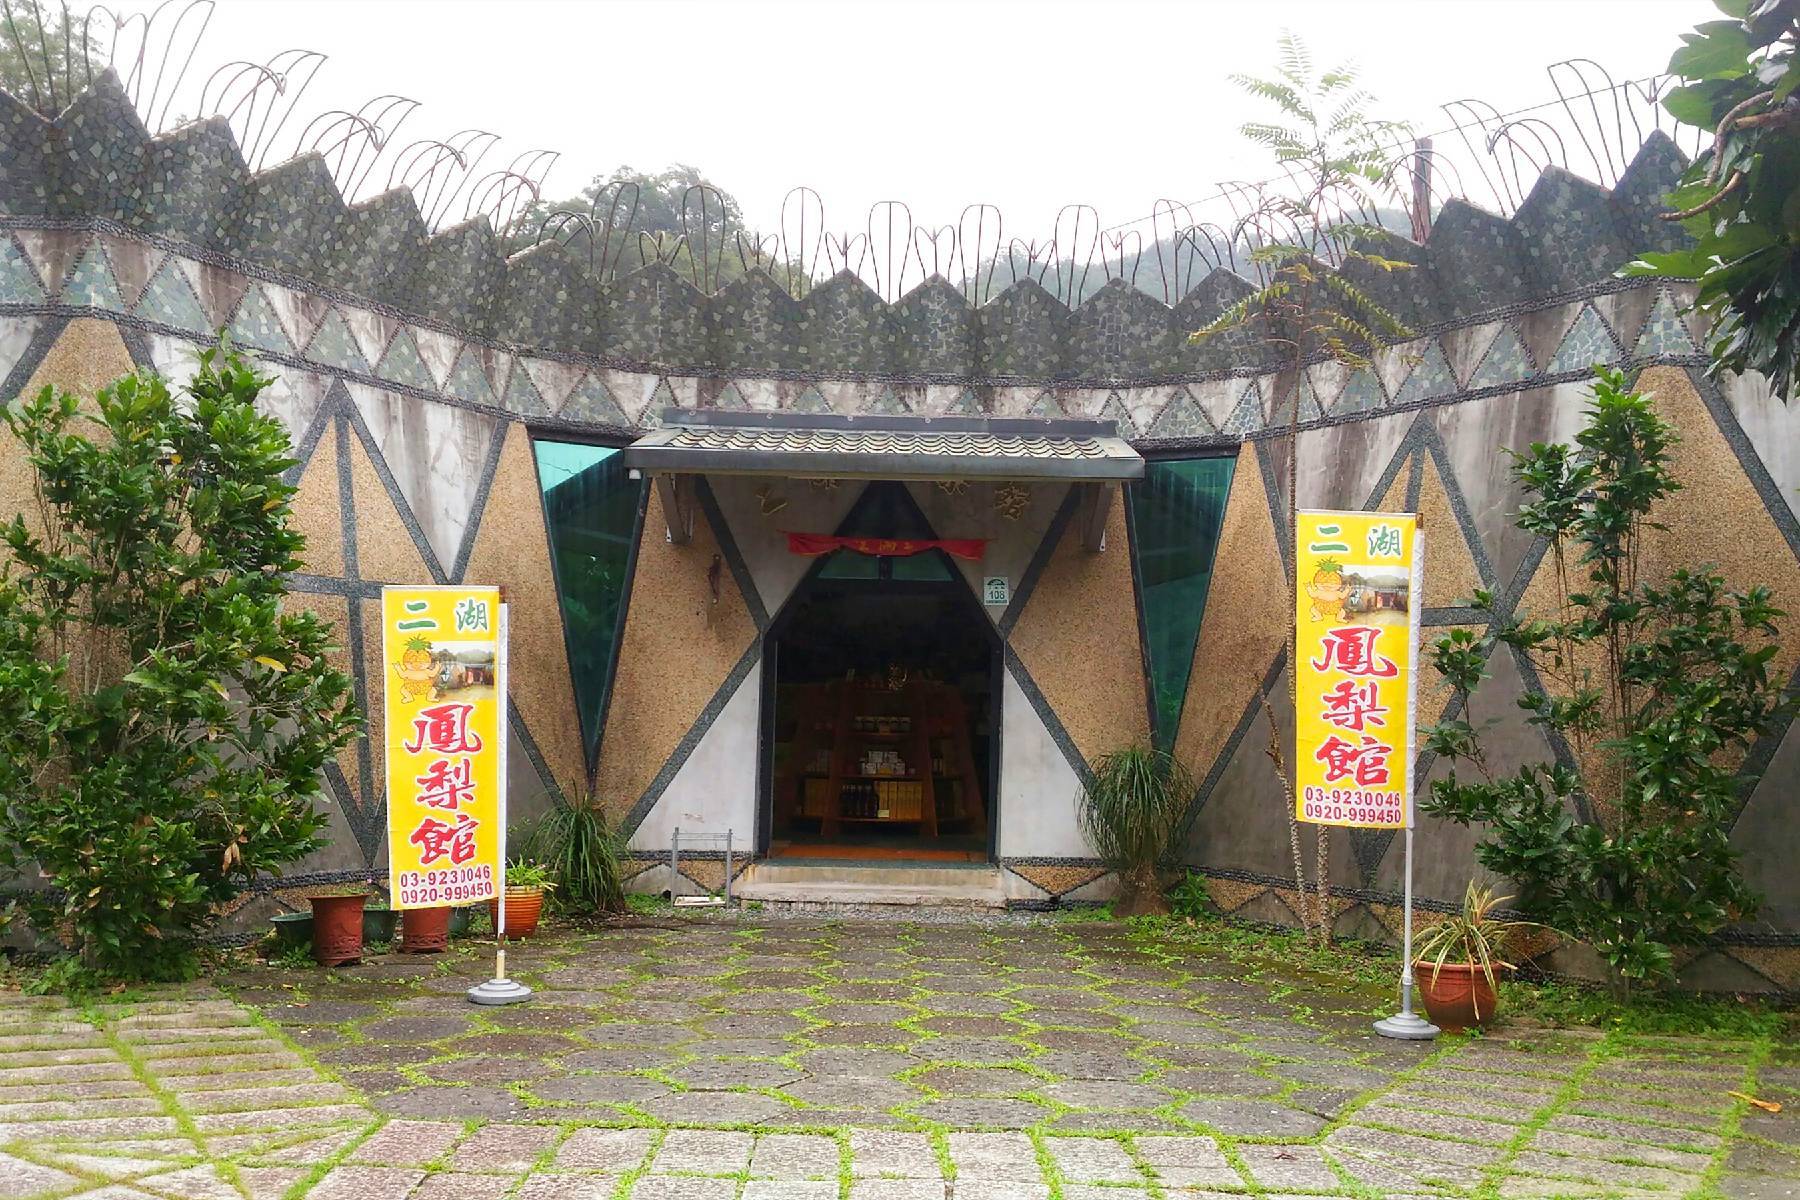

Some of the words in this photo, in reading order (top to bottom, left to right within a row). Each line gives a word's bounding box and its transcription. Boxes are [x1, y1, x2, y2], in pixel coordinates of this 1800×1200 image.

[1310, 525, 1401, 556] 二湖
[989, 590, 1005, 600] 108
[398, 599, 488, 631] 二湖
[1312, 627, 1398, 788] 鳳梨館
[405, 704, 483, 865] 鳳梨館
[1305, 786, 1400, 807] 03-9230046
[1305, 803, 1401, 824] 0920-999450
[400, 865, 491, 888] 03-9230046
[401, 881, 492, 904] 0920-999450
